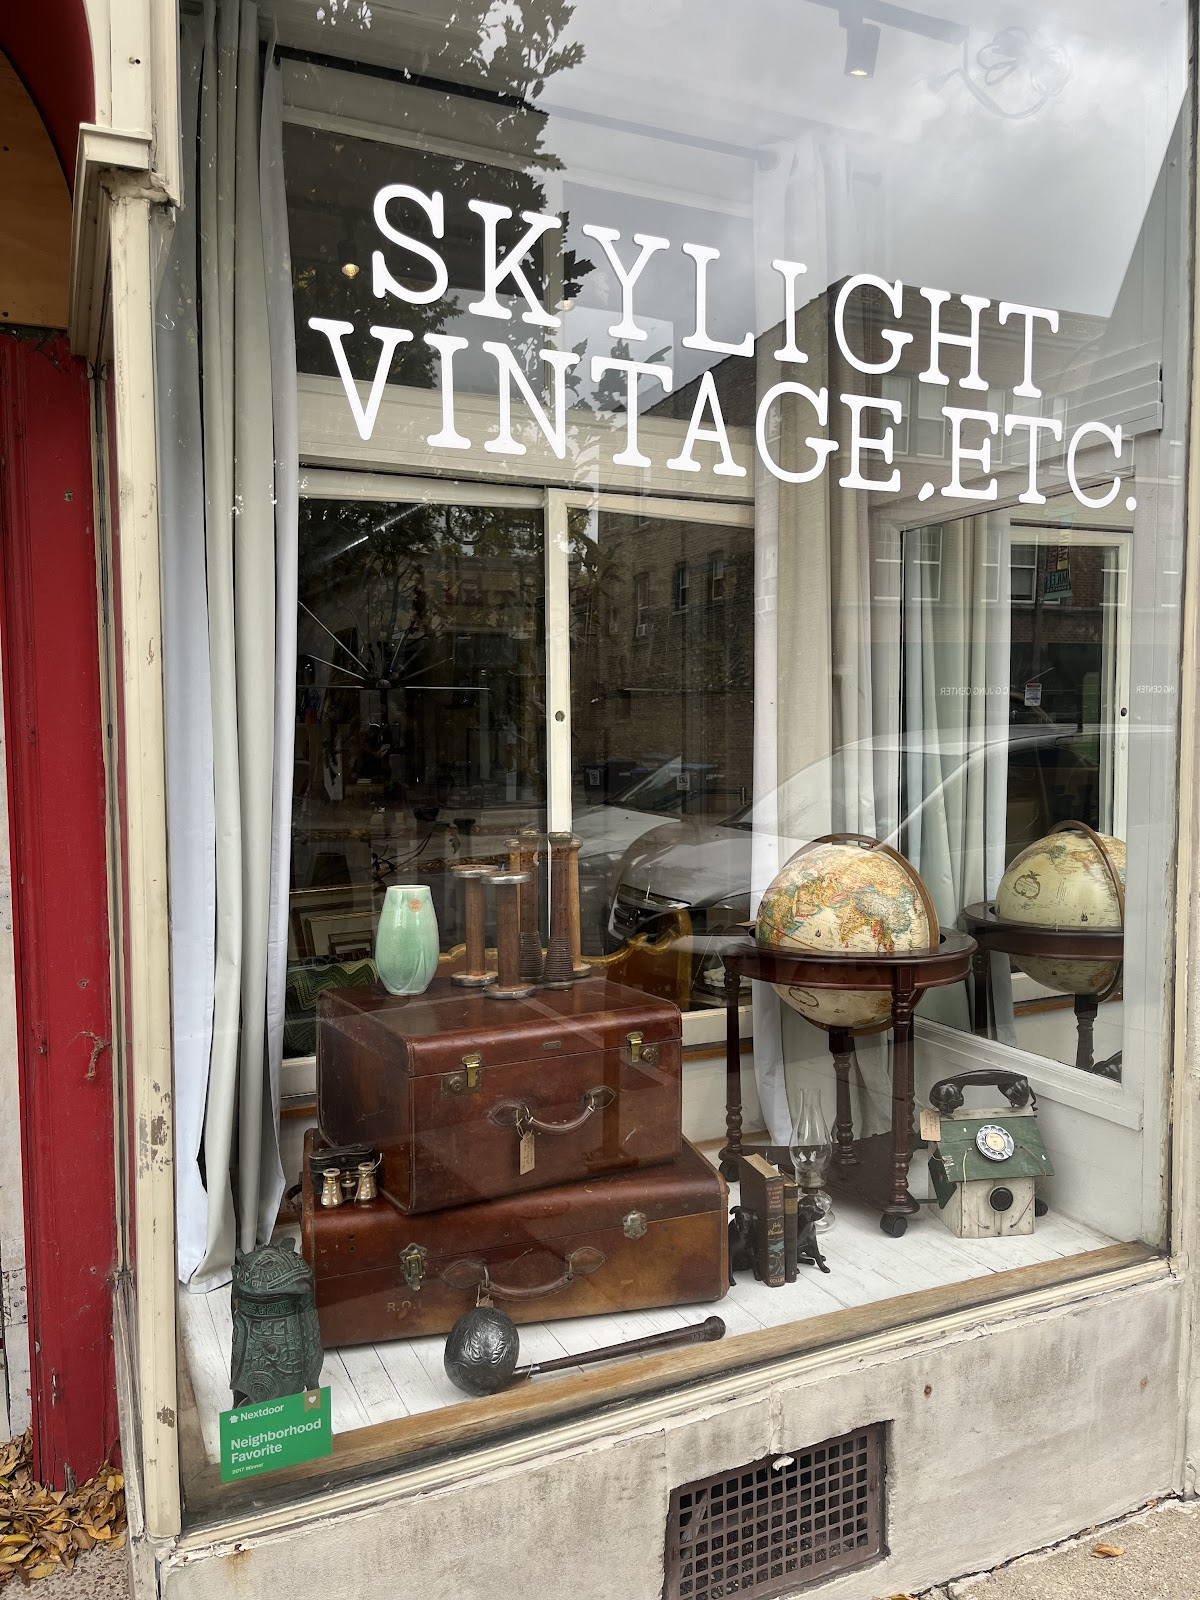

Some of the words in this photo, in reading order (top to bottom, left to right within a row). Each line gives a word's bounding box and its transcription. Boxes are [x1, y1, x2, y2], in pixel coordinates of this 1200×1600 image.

[372, 183, 1060, 399] SKYLIGHT
[240, 1404, 284, 1422] Nextdoor
[230, 1418, 322, 1451] Neighborhood
[231, 1443, 283, 1464] Favorite
[231, 1466, 245, 1475] 2017
[245, 1462, 264, 1472] Winner
